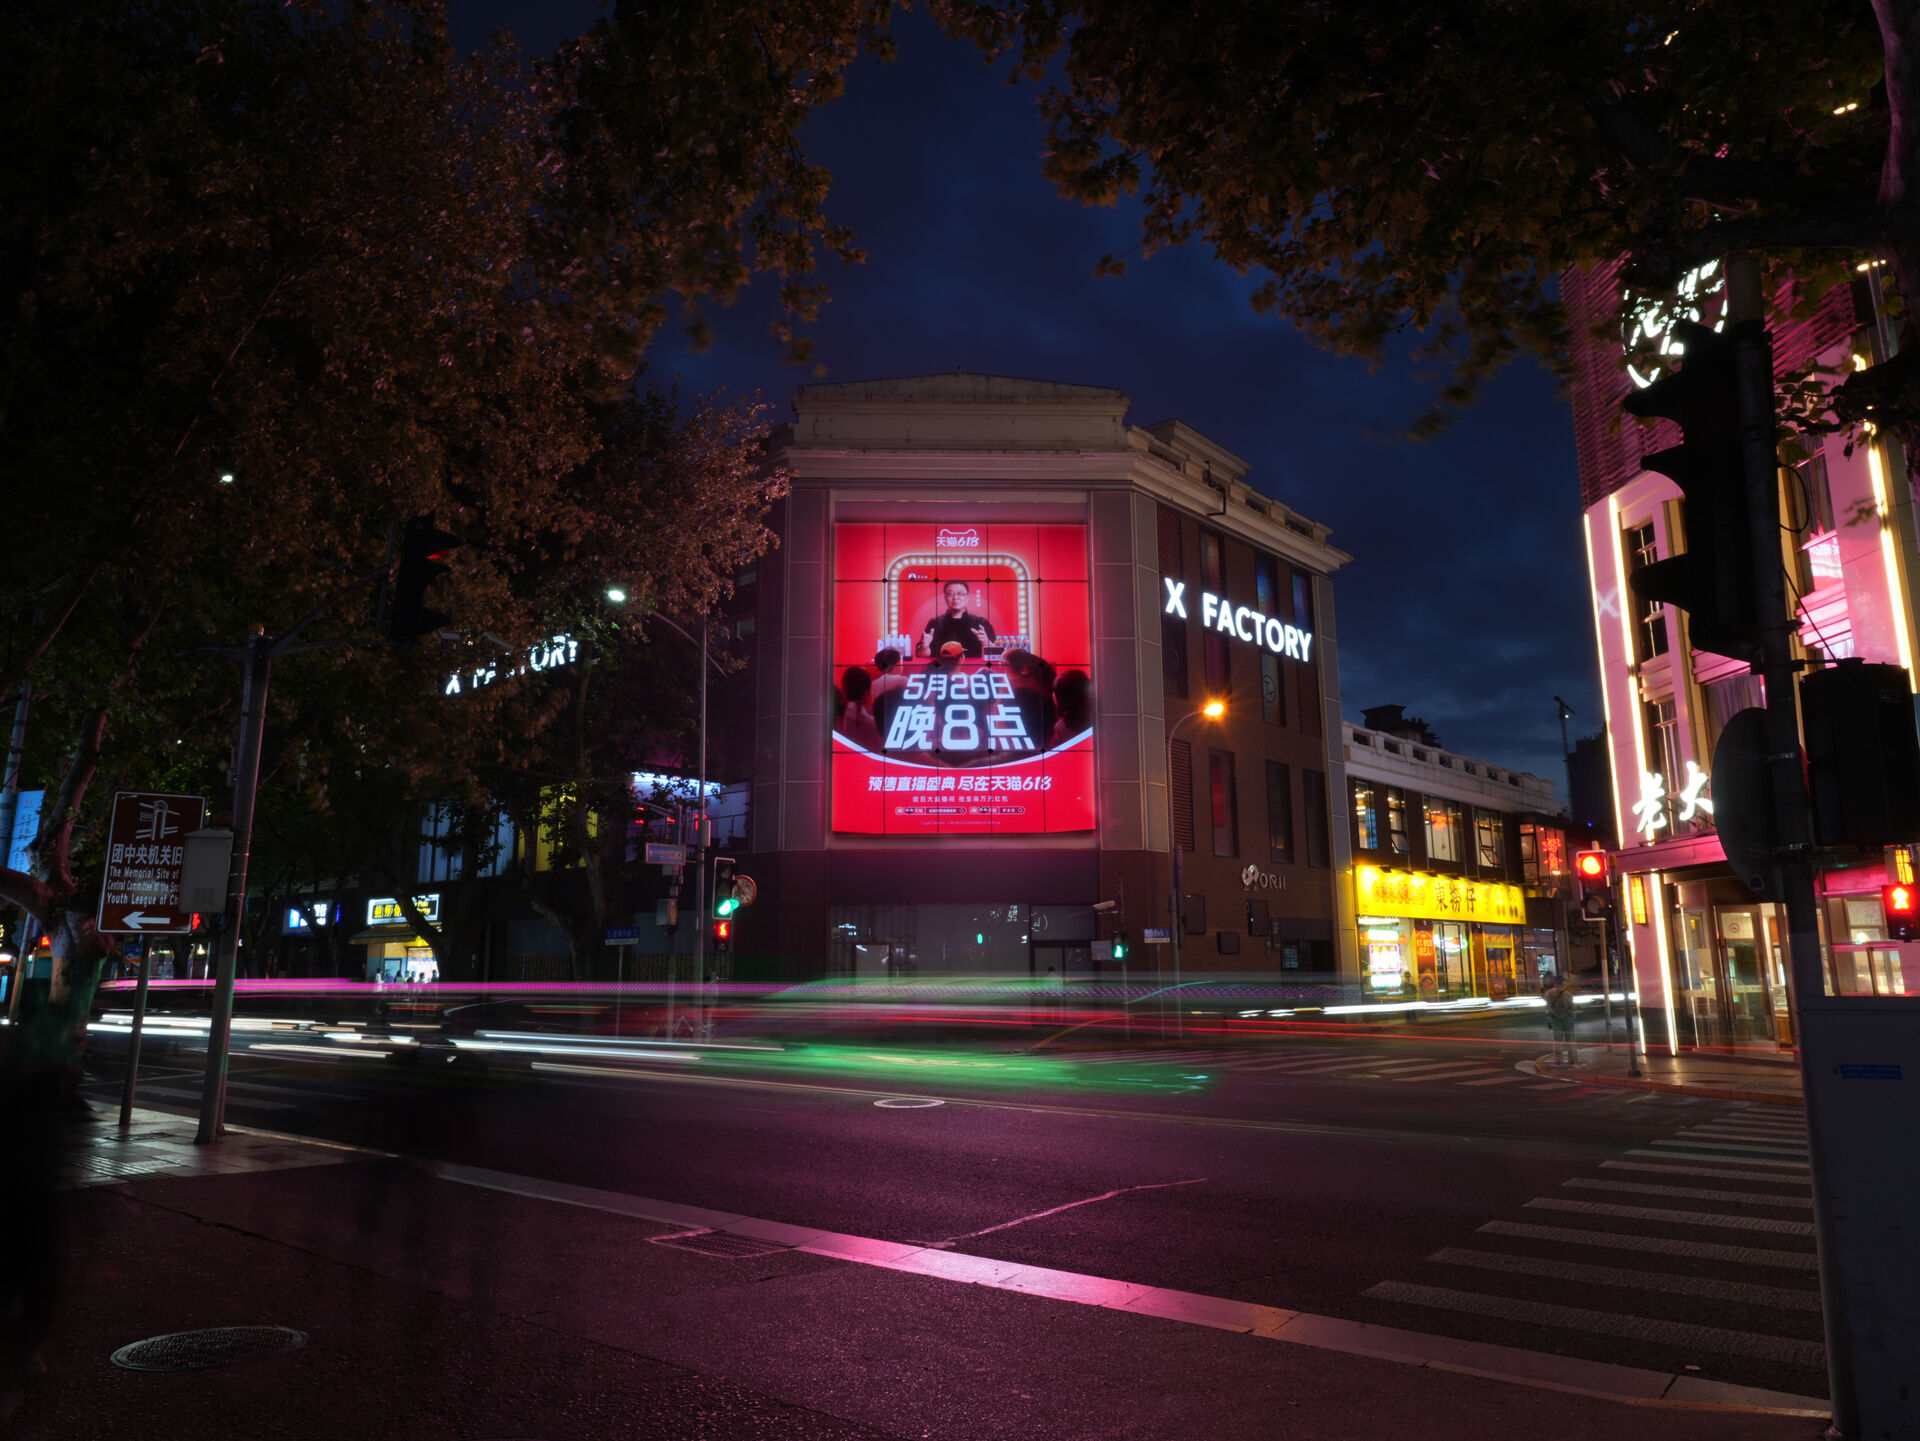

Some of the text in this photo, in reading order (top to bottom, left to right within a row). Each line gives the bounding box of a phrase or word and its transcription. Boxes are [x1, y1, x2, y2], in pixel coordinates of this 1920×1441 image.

[936, 536, 980, 548] 天猫618
[1164, 577, 1312, 663] X FACTORY
[903, 673, 1016, 700] 5月26日
[884, 704, 1035, 751] 晚8点
[868, 776, 1053, 791] 预售直播盛典 尽在天猫618
[111, 843, 184, 865] 团中央机关旧
[110, 865, 180, 880] The Memorial Site of
[107, 879, 126, 890] Central
[127, 880, 152, 892] Committee
[107, 892, 128, 905] Youth
[131, 893, 157, 908] League
[160, 894, 168, 905] of
